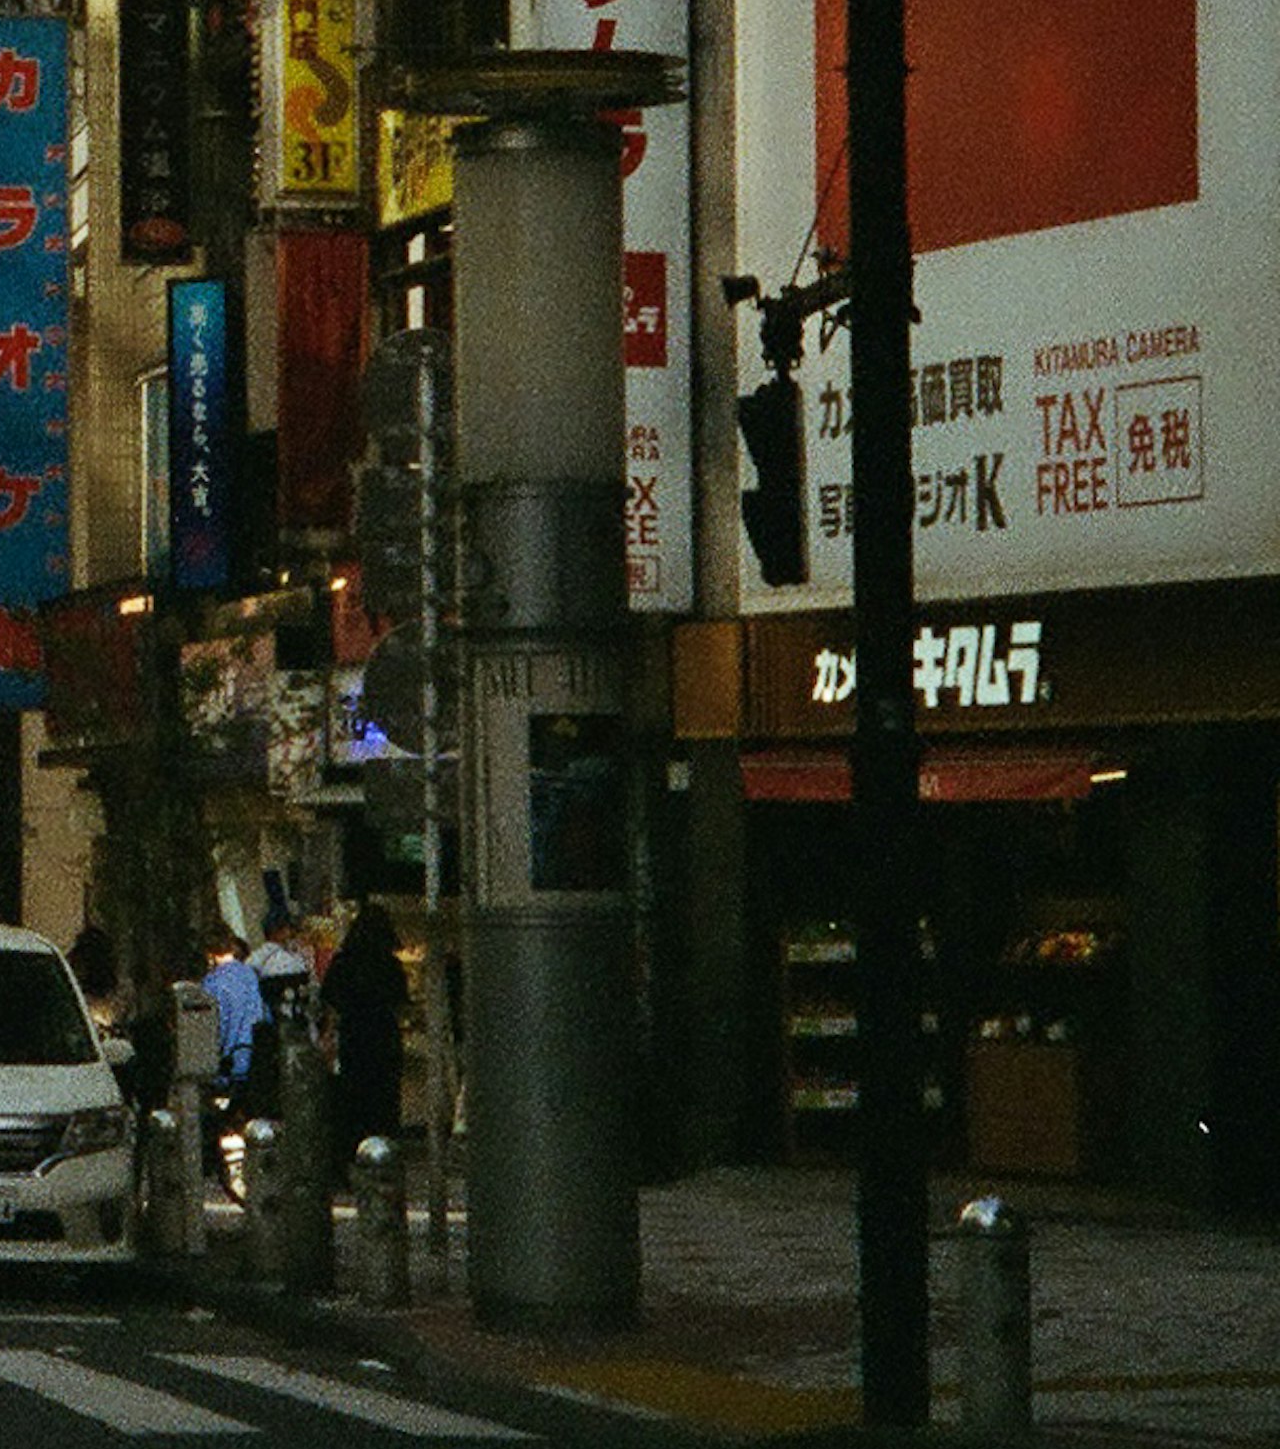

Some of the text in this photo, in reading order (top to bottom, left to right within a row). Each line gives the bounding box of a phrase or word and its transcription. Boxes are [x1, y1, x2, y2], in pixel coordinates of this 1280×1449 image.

[293, 142, 345, 182] 3F
[1034, 324, 1200, 378] KITAMURA CAMERA
[1034, 389, 1108, 456] TAX
[1126, 407, 1193, 474] 免税
[1037, 454, 1109, 515] FREE
